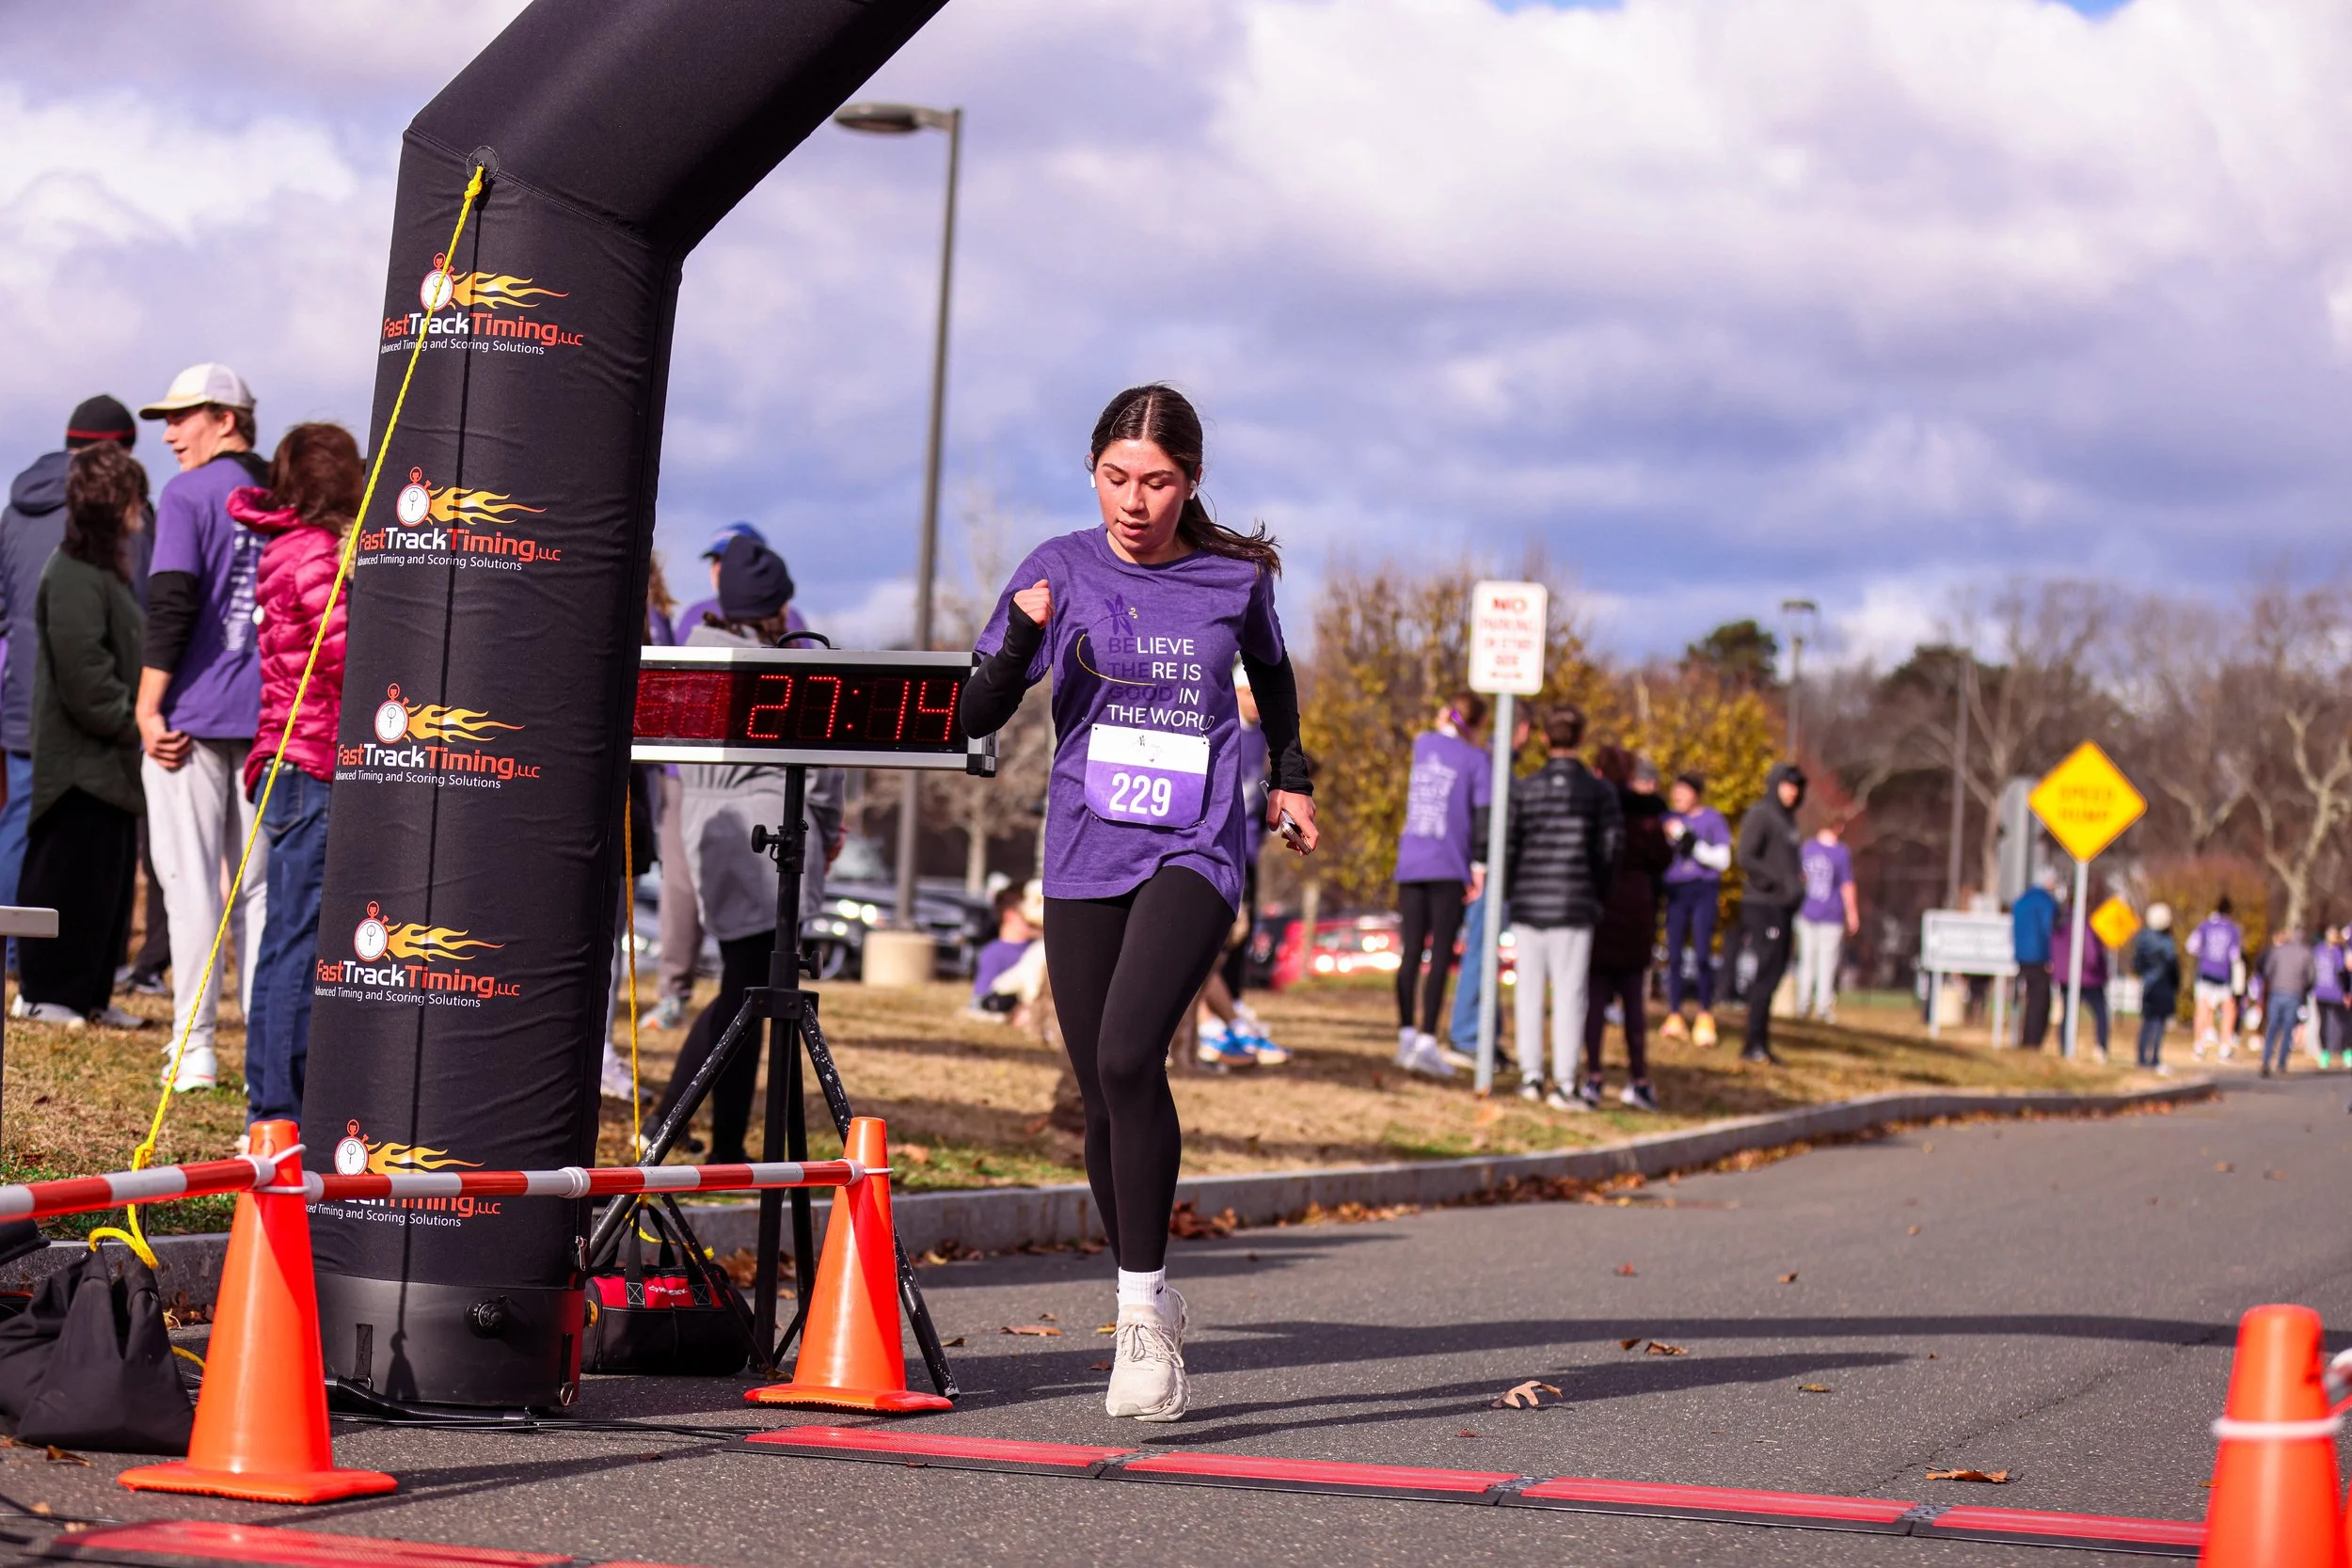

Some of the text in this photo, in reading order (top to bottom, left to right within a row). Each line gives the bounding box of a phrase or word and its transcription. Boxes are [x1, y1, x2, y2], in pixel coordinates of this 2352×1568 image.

[403, 339, 428, 352] Timig
[430, 339, 447, 349] and
[451, 339, 489, 352] Scoring
[492, 341, 545, 356] Solutions
[380, 553, 405, 567] Timing
[407, 554, 424, 564] and
[427, 555, 467, 569] Scoring
[469, 557, 522, 571] Solutions
[1108, 637, 1195, 656] BELIEVE
[1106, 661, 1202, 681] THERE IS
[1108, 686, 1200, 705] GOOD IN
[746, 674, 960, 741] 27:14
[1106, 705, 1206, 731] THE WORL
[358, 769, 383, 784] Timing
[385, 771, 403, 782] and
[405, 772, 445, 787] Scoring
[449, 774, 501, 789] Solutions
[1108, 772, 1172, 817] 229
[338, 987, 363, 1002] Timing
[365, 990, 383, 1001] and
[386, 991, 424, 1006] Scoring
[428, 993, 481, 1007] Solutions
[318, 1204, 343, 1220] Timing
[345, 1209, 363, 1220] and
[366, 1210, 405, 1227] Scoring
[409, 1213, 461, 1227] Solutions
